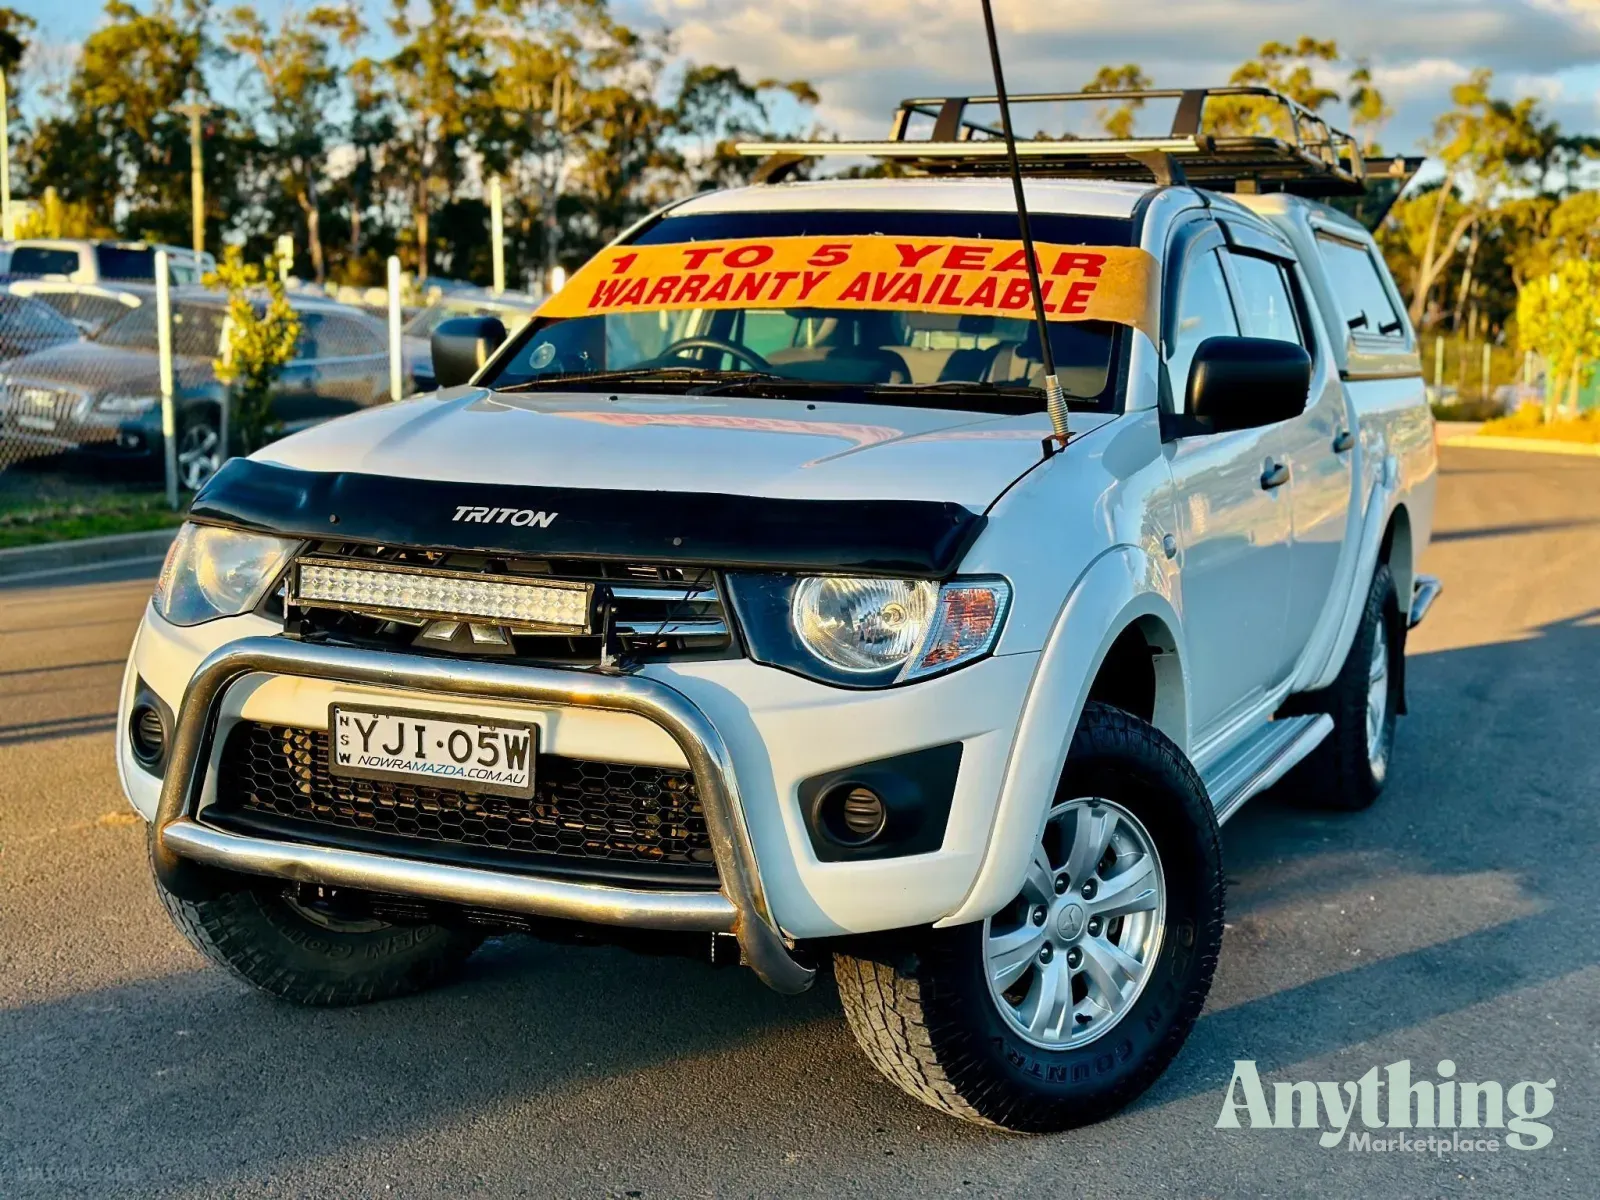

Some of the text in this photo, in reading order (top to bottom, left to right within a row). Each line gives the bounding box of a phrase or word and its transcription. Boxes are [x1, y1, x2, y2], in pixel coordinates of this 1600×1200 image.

[612, 243, 1107, 277] 1 TO 5 YEAR
[587, 271, 1097, 314] WARRANTY AVAILABLE
[452, 505, 559, 528] TRITON
[357, 755, 525, 784] NOWRAMAZDA.COM.AU
